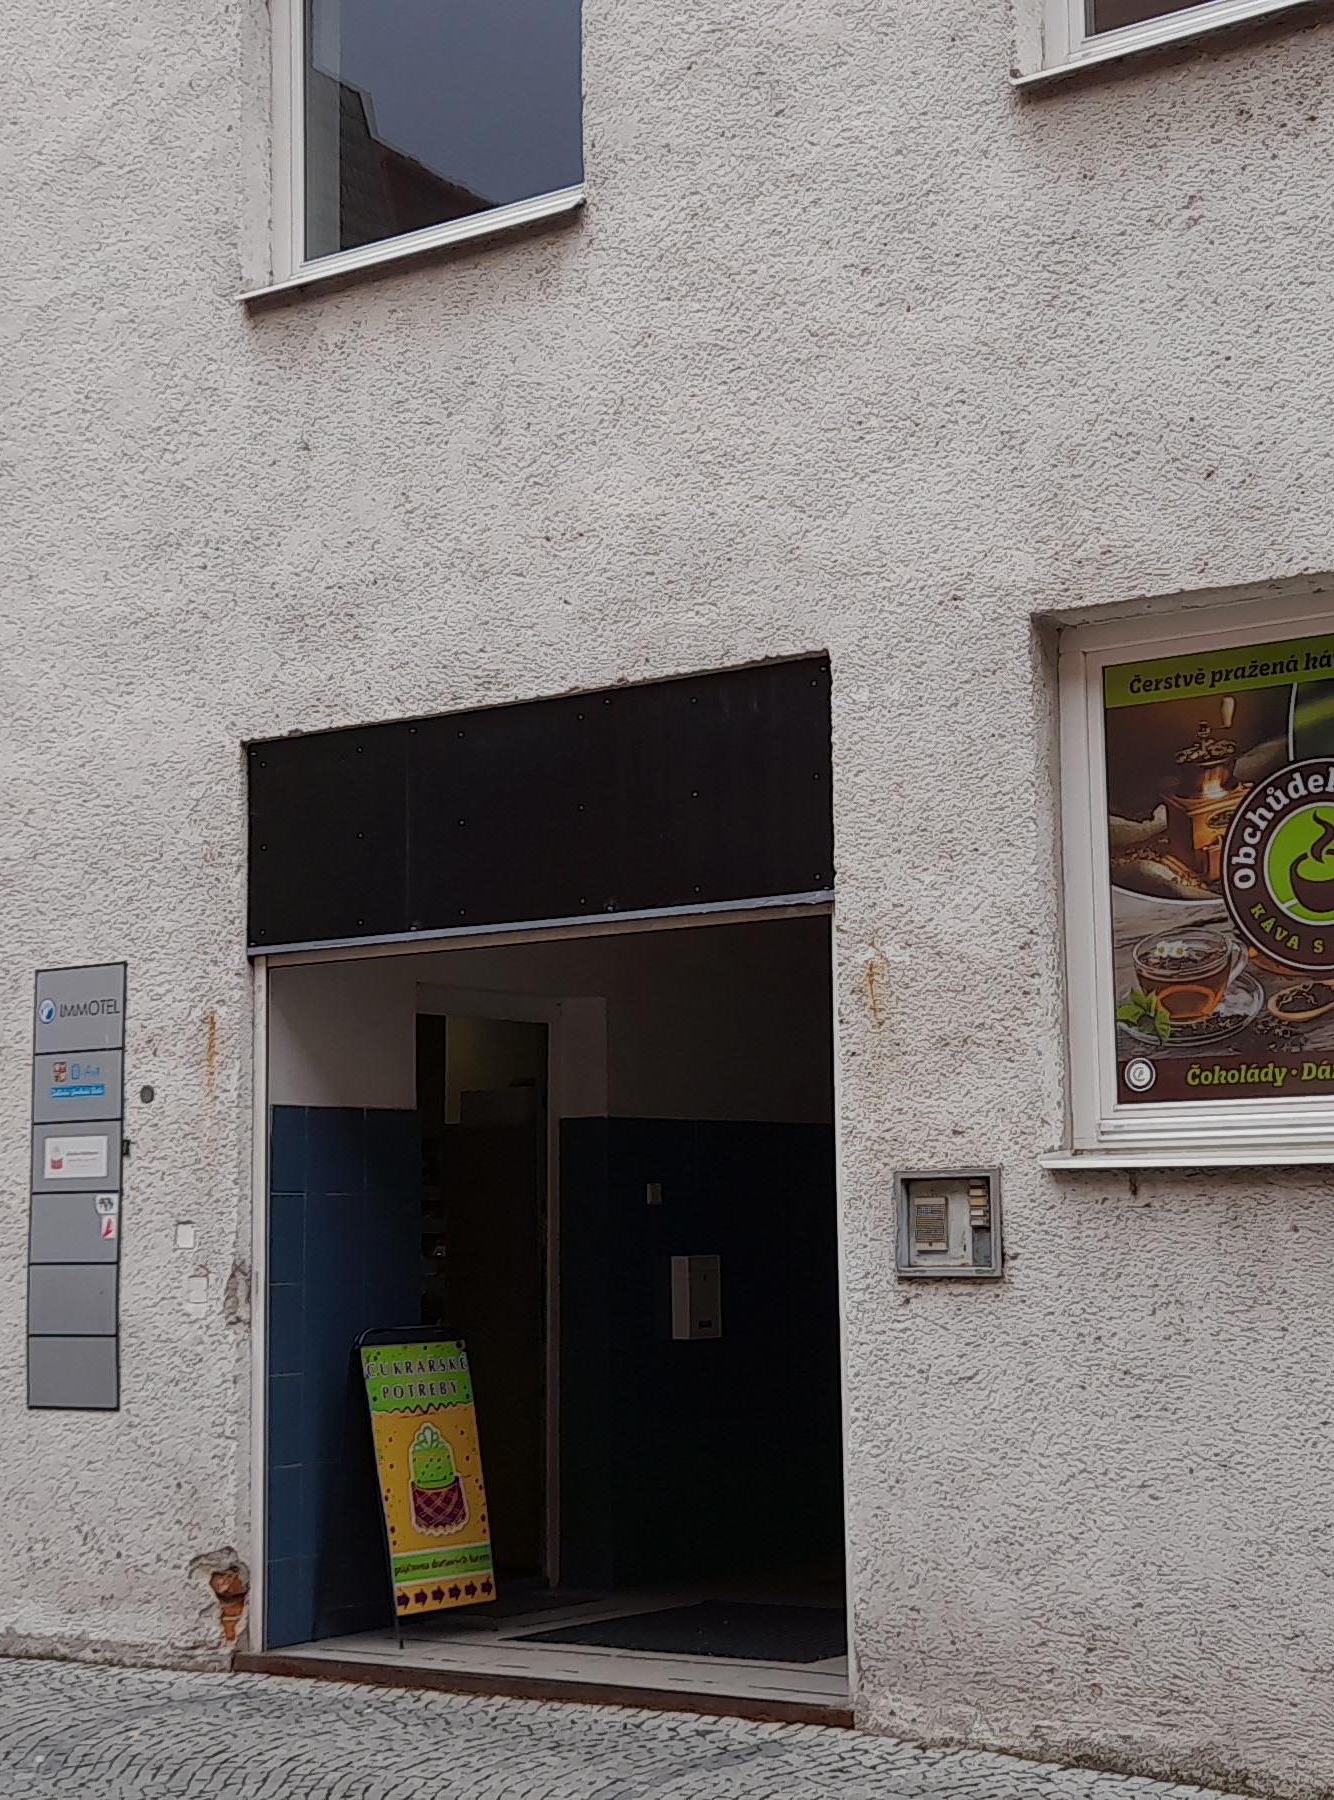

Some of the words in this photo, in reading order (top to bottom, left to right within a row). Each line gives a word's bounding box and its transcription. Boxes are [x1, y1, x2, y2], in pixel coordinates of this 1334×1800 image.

[1129, 668, 1206, 694] Čerstvě
[1209, 655, 1299, 688] pražená
[1250, 903, 1300, 951] KÁVA
[1313, 939, 1325, 954] S
[59, 999, 120, 1018] IMMOTEL
[1186, 1063, 1287, 1087] Čokolády
[367, 1353, 467, 1377] CUKRÁŘSKÉ
[382, 1380, 457, 1399] POTŘEBY
